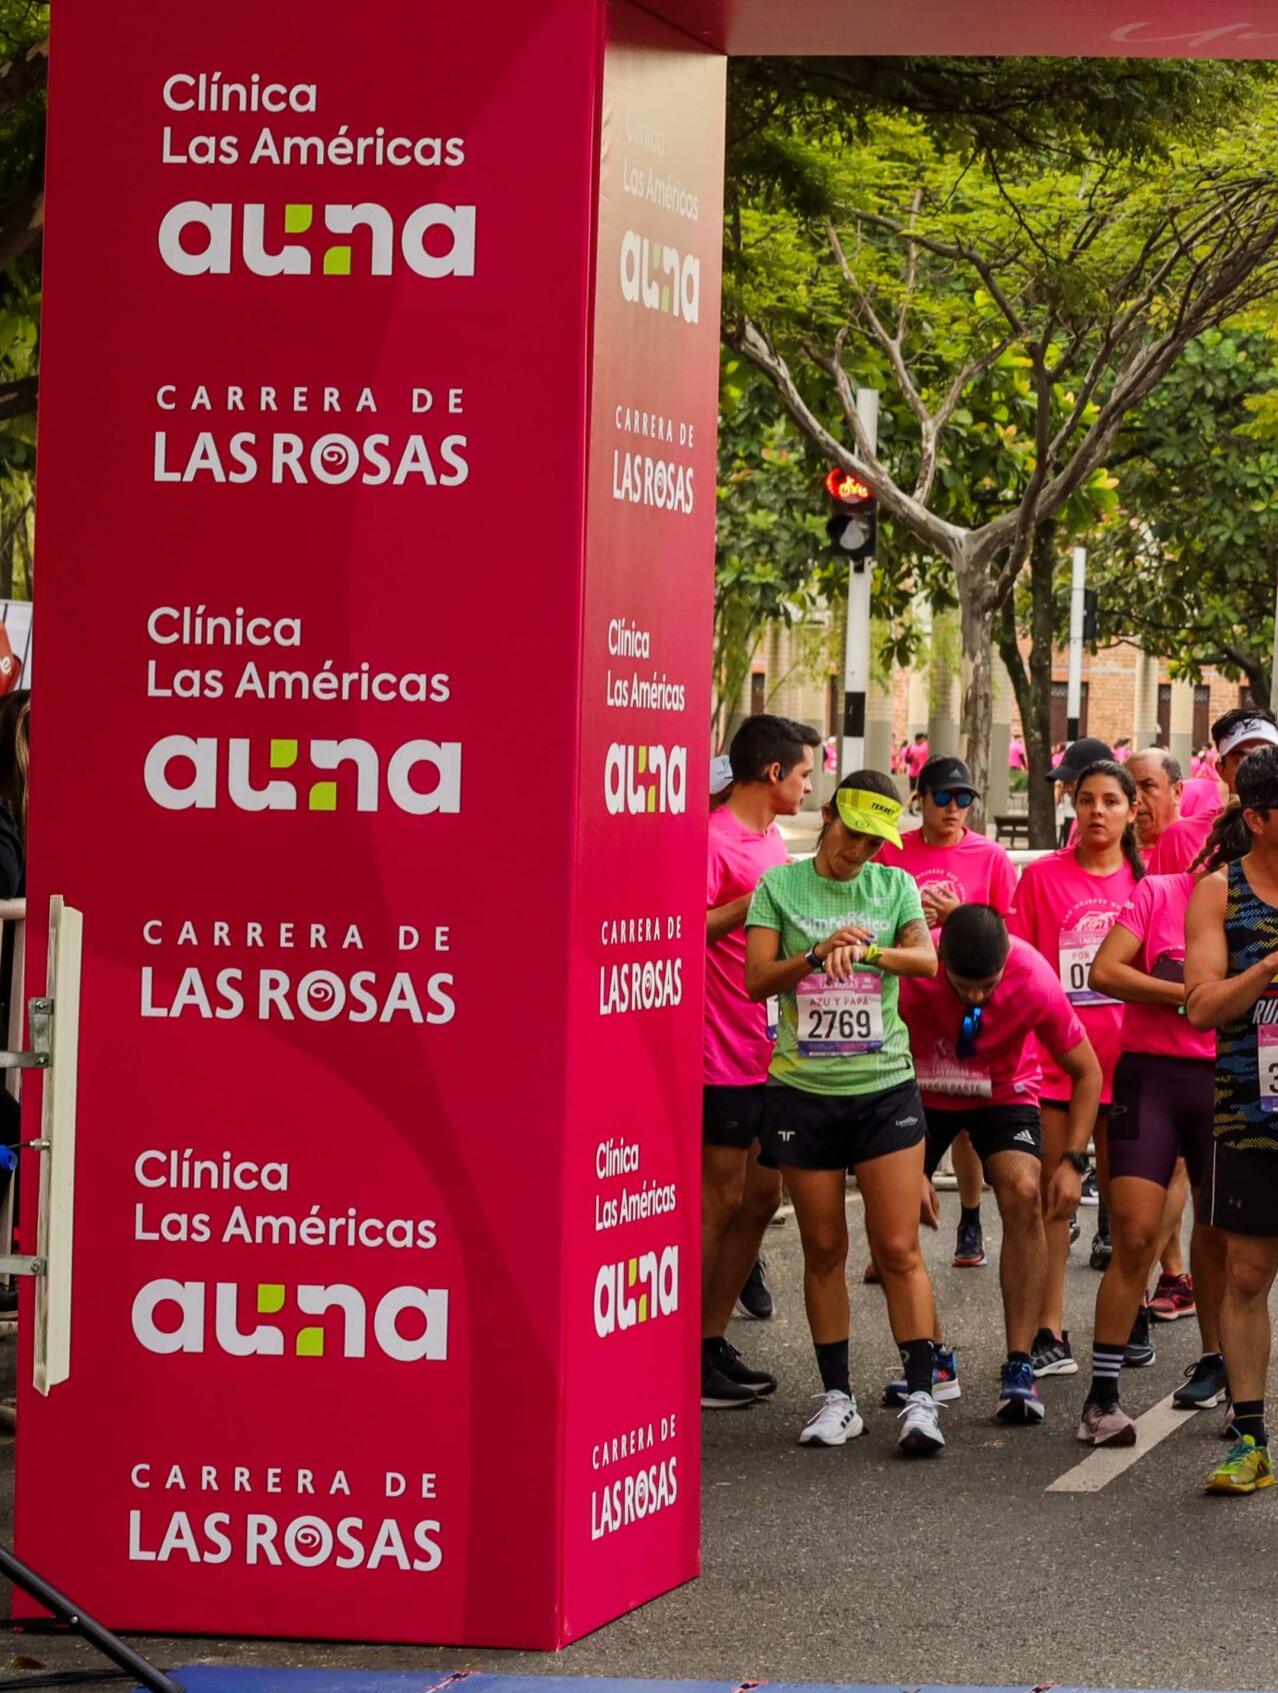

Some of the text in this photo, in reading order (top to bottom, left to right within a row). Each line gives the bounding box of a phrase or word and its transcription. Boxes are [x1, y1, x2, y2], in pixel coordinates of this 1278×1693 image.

[163, 72, 316, 112] Clínica
[163, 126, 464, 166] Las Américas
[623, 155, 698, 221] Las Américas
[159, 201, 476, 278] auna
[621, 230, 700, 323] auna
[157, 385, 462, 413] CARRERA DE
[616, 406, 693, 447] CARRERA DE
[155, 432, 468, 486] LAS ROSAS
[614, 450, 693, 513] LAS ROSAS
[148, 605, 300, 646] Clínica
[609, 618, 649, 658] Clínica
[148, 660, 449, 702] Las Américas
[607, 670, 684, 711] Las Américas
[144, 735, 461, 814] auna
[605, 743, 686, 814] auna
[144, 920, 449, 950] CARRERA DE
[602, 916, 681, 944] CARRERA DE
[141, 967, 455, 1024] LAS ROSAS
[600, 958, 681, 1014] LAS ROSAS
[808, 1010, 872, 1039] 2769
[135, 1149, 287, 1191] Clínica
[597, 1138, 638, 1178] Clínica
[135, 1204, 436, 1248] Las Américas
[596, 1180, 675, 1230] Las Américas
[594, 1246, 678, 1337] auna
[132, 1279, 448, 1361] auna
[593, 1414, 675, 1472] CARRERA DE
[132, 1464, 435, 1498] CARRERA DE
[592, 1457, 677, 1540] LAS ROSAS
[130, 1510, 441, 1571] LAS ROSAS
